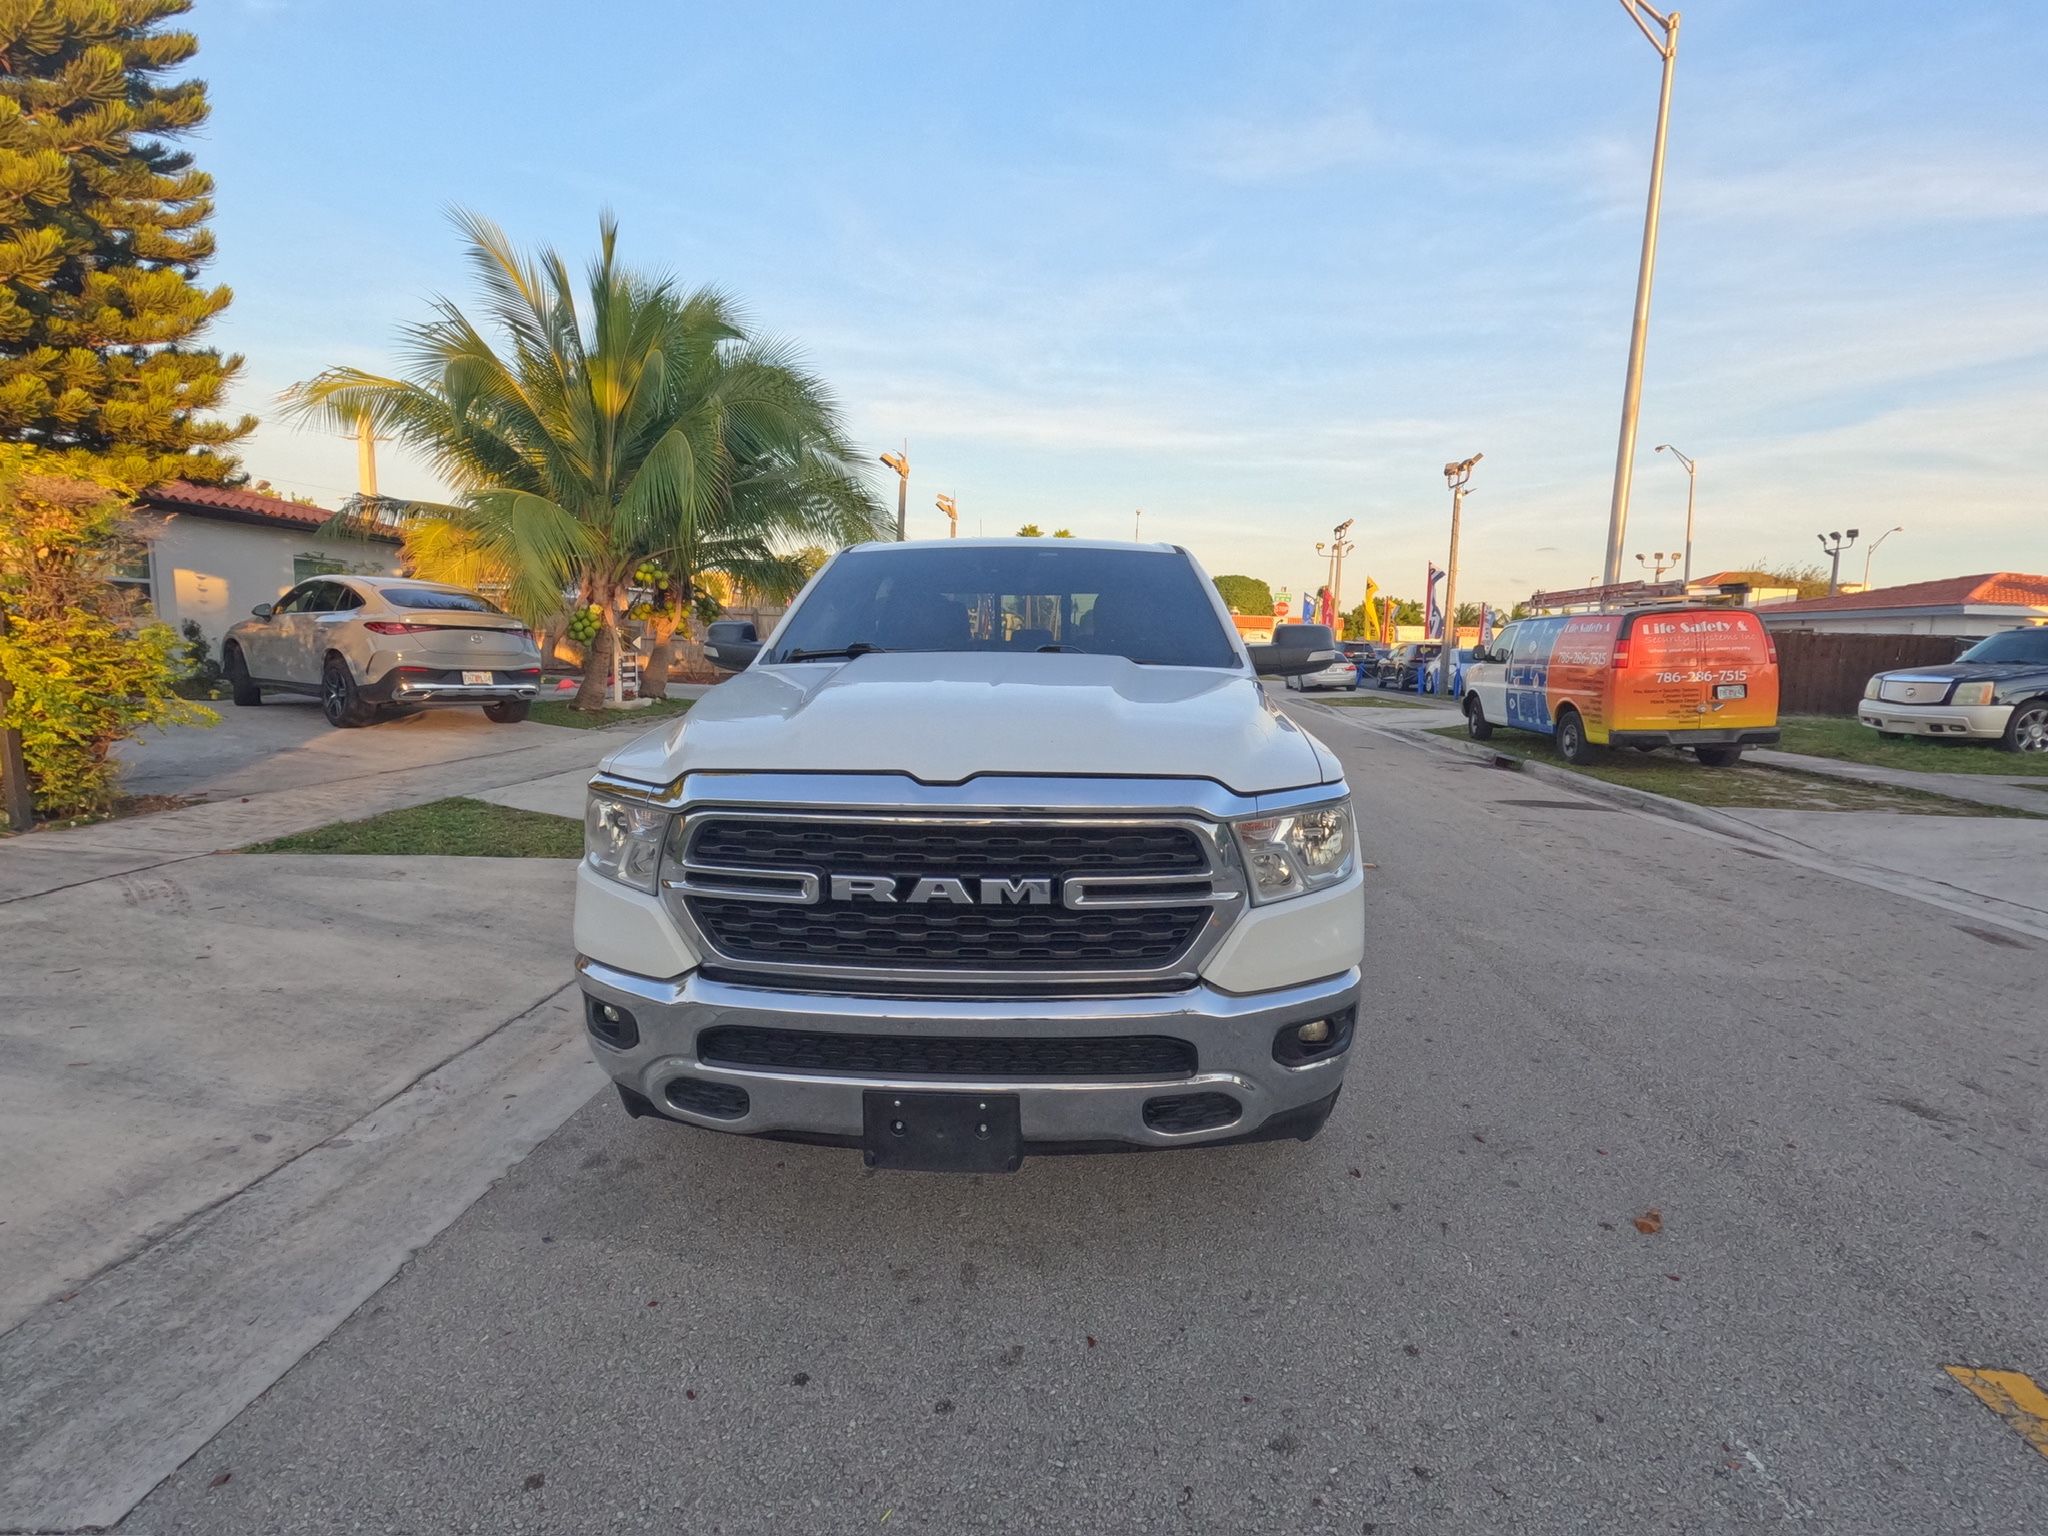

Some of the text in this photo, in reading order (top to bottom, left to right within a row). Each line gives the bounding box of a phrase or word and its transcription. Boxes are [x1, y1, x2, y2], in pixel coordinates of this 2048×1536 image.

[1642, 620, 1749, 635] Life Safety &
[1656, 670, 1747, 683] 786-286-7515
[831, 874, 1051, 904] RAM
